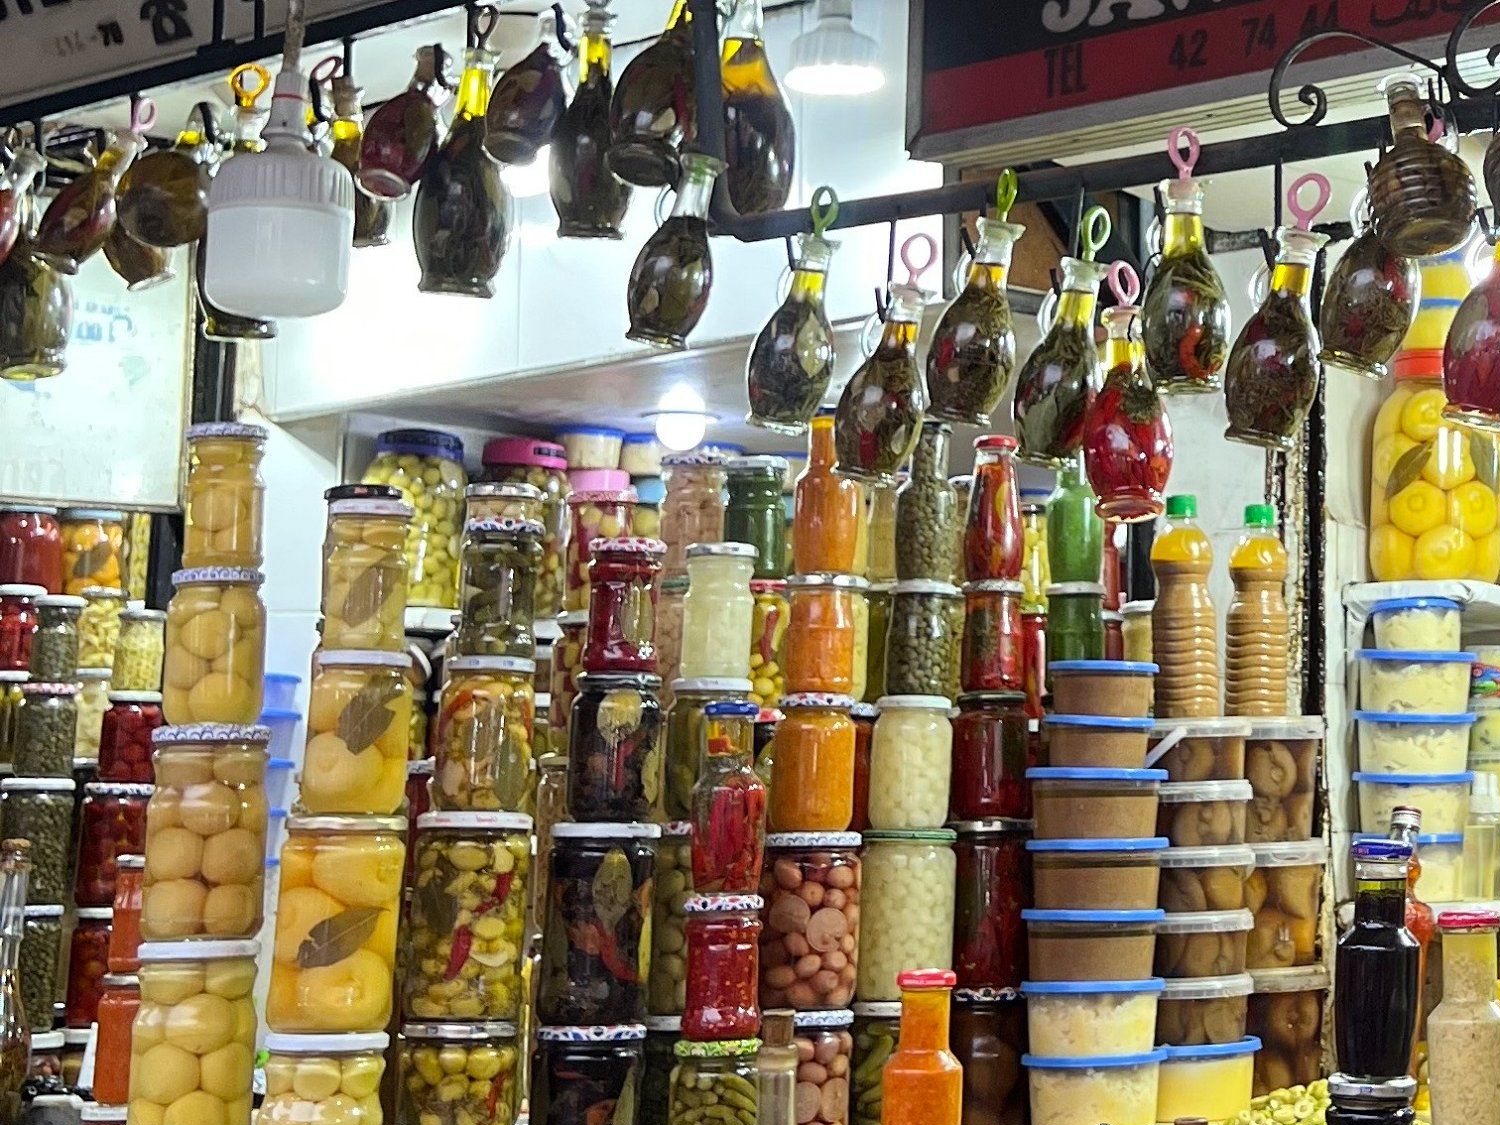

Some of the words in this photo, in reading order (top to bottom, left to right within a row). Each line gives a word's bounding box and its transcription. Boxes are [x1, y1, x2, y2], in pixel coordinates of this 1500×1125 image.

[1043, 42, 1088, 99] TEL
[1168, 28, 1208, 71] 42
[1241, 13, 1277, 58] 74
